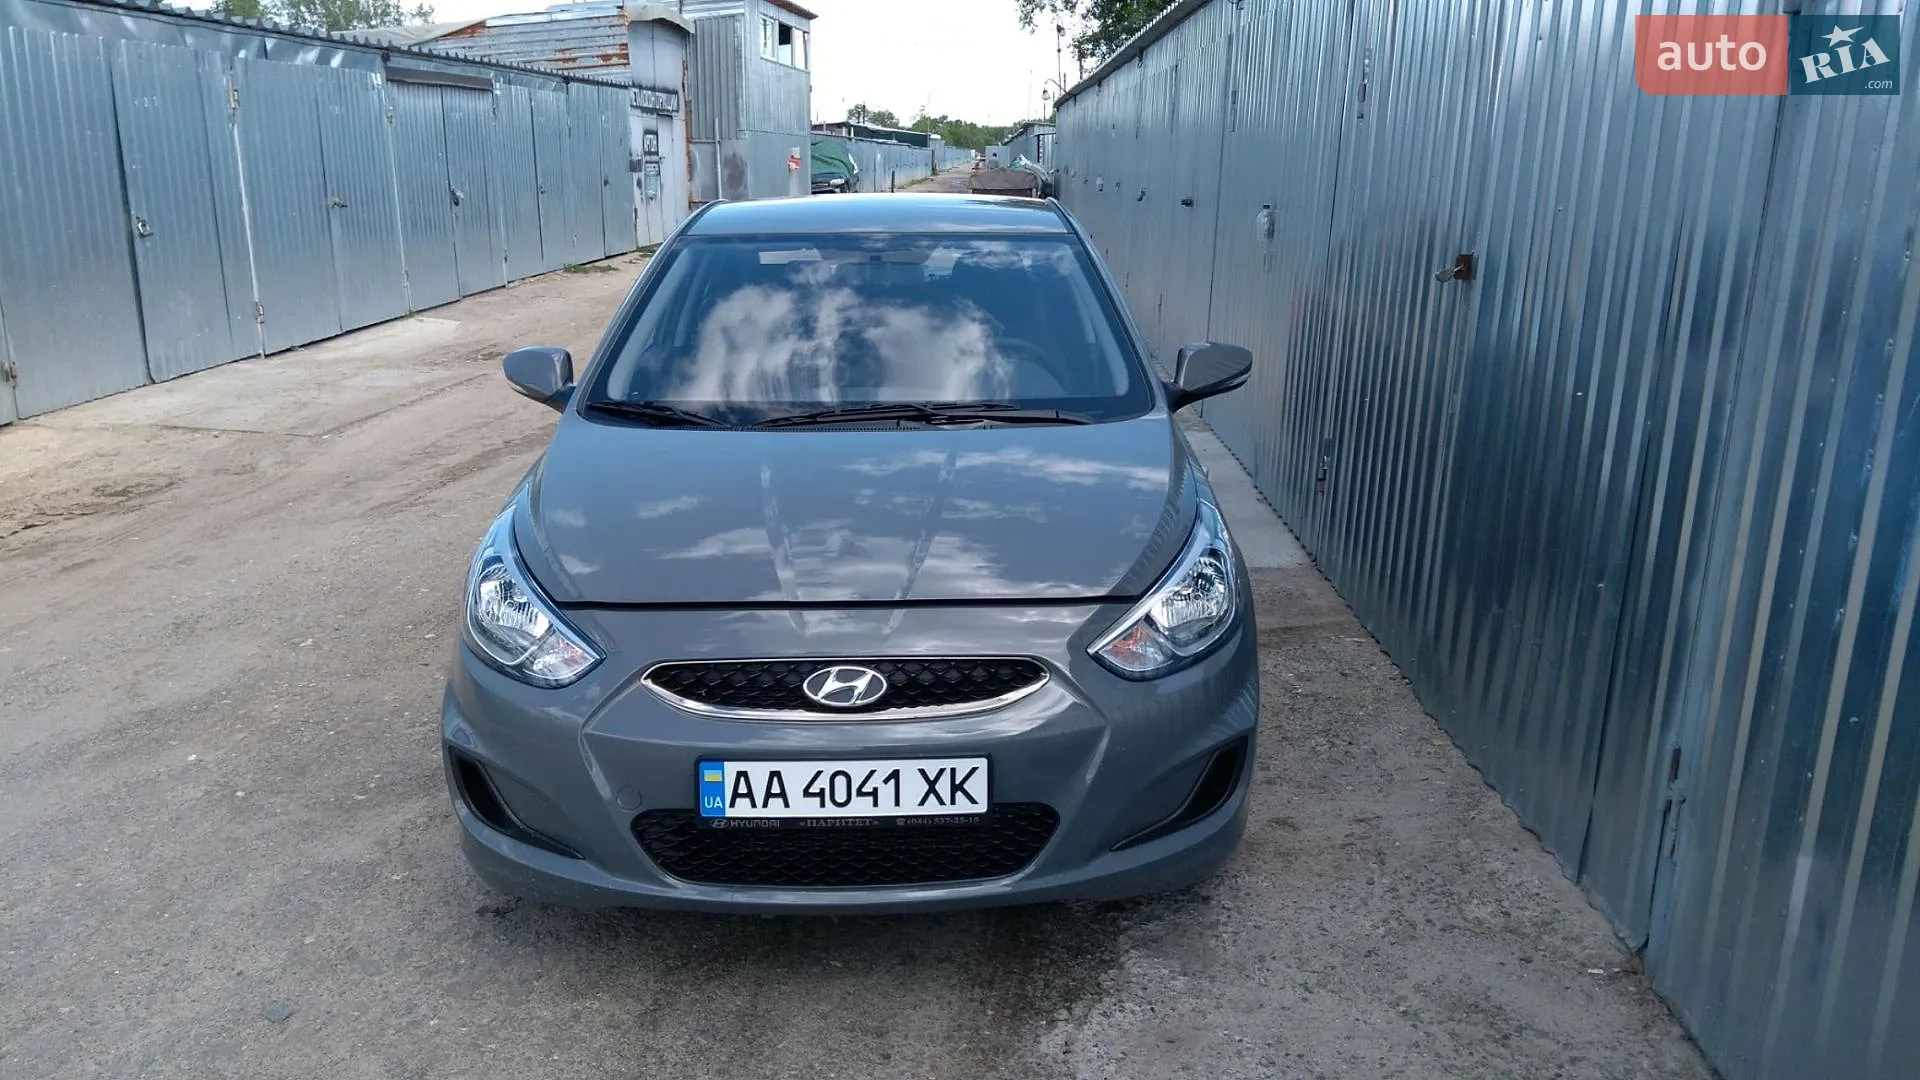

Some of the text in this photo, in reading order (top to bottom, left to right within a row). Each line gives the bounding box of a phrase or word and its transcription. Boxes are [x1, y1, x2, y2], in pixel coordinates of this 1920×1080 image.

[728, 766, 980, 809] AA 4041 XK
[704, 795, 723, 809] UA
[730, 819, 780, 828] HYUNDAI
